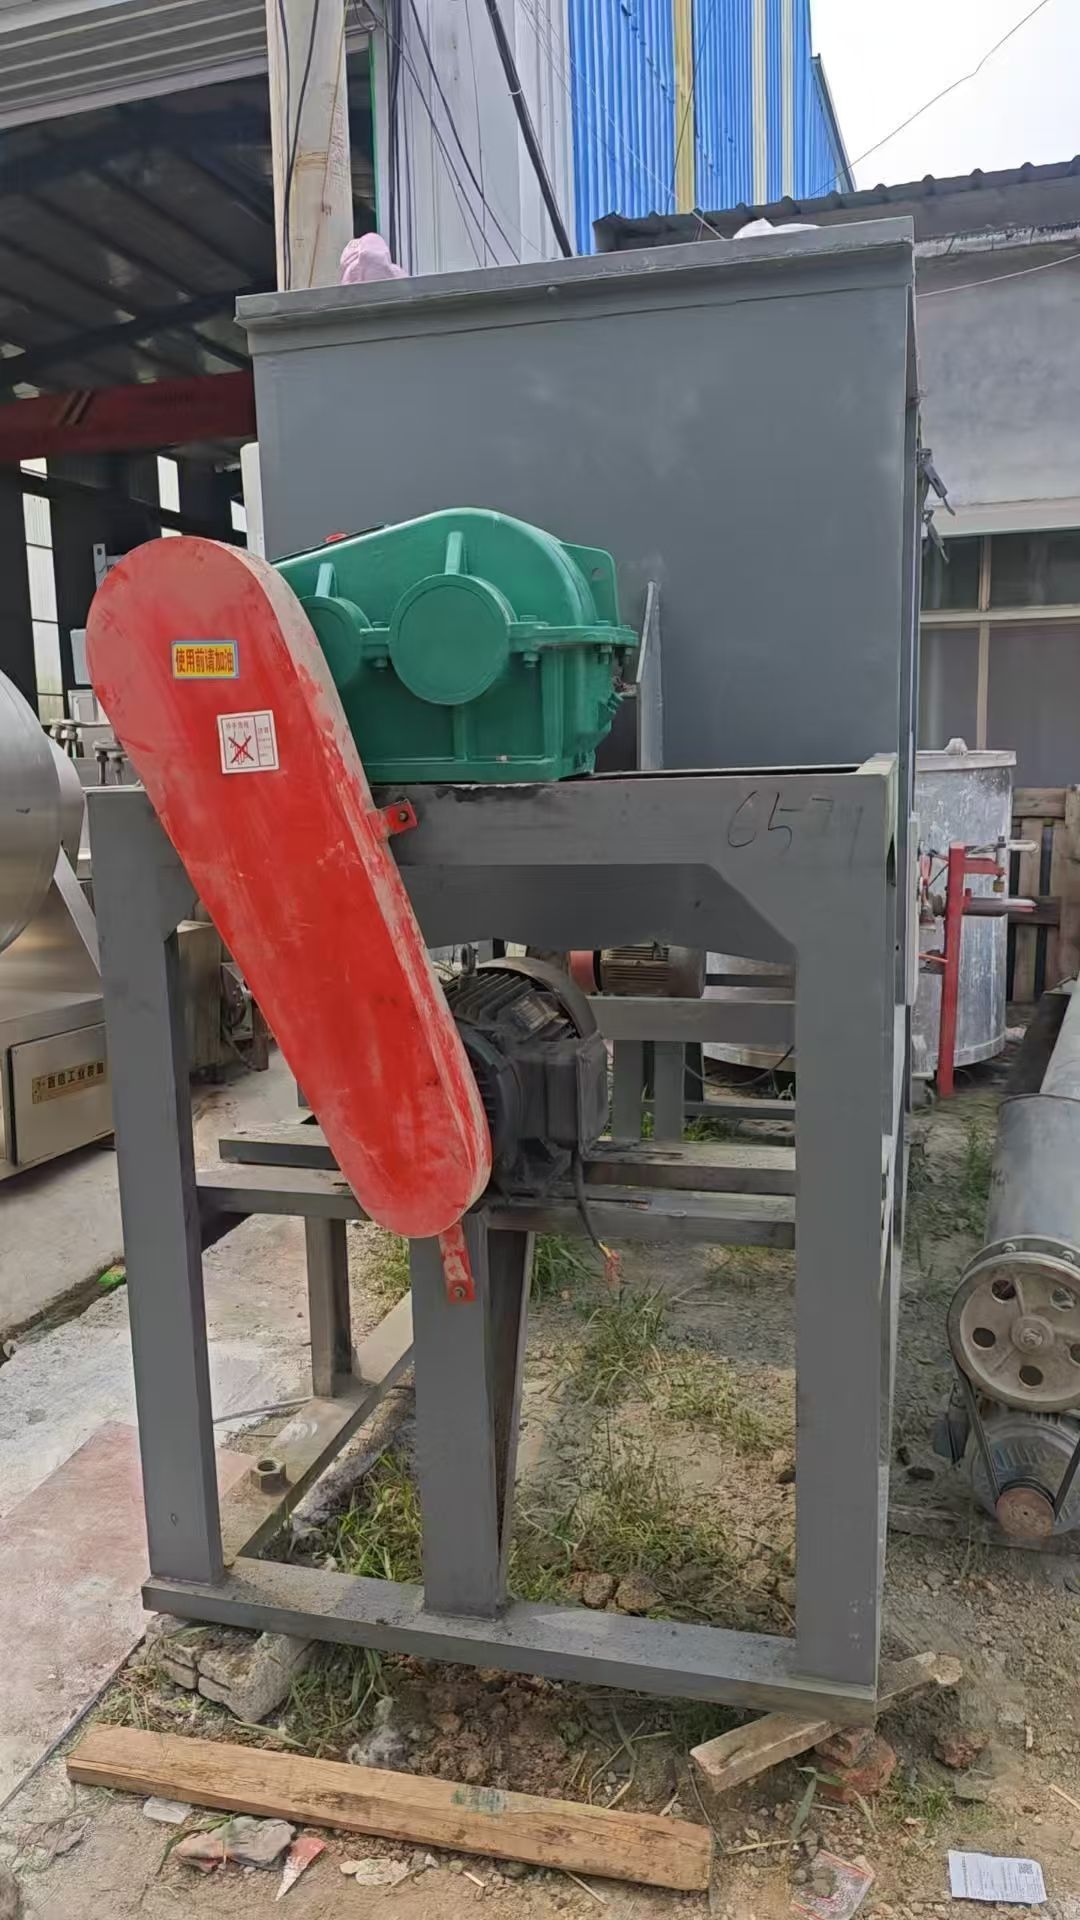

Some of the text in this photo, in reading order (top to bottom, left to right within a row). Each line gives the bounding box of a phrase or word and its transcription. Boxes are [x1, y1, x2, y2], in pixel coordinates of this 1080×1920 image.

[175, 647, 234, 673] 使用前请加油
